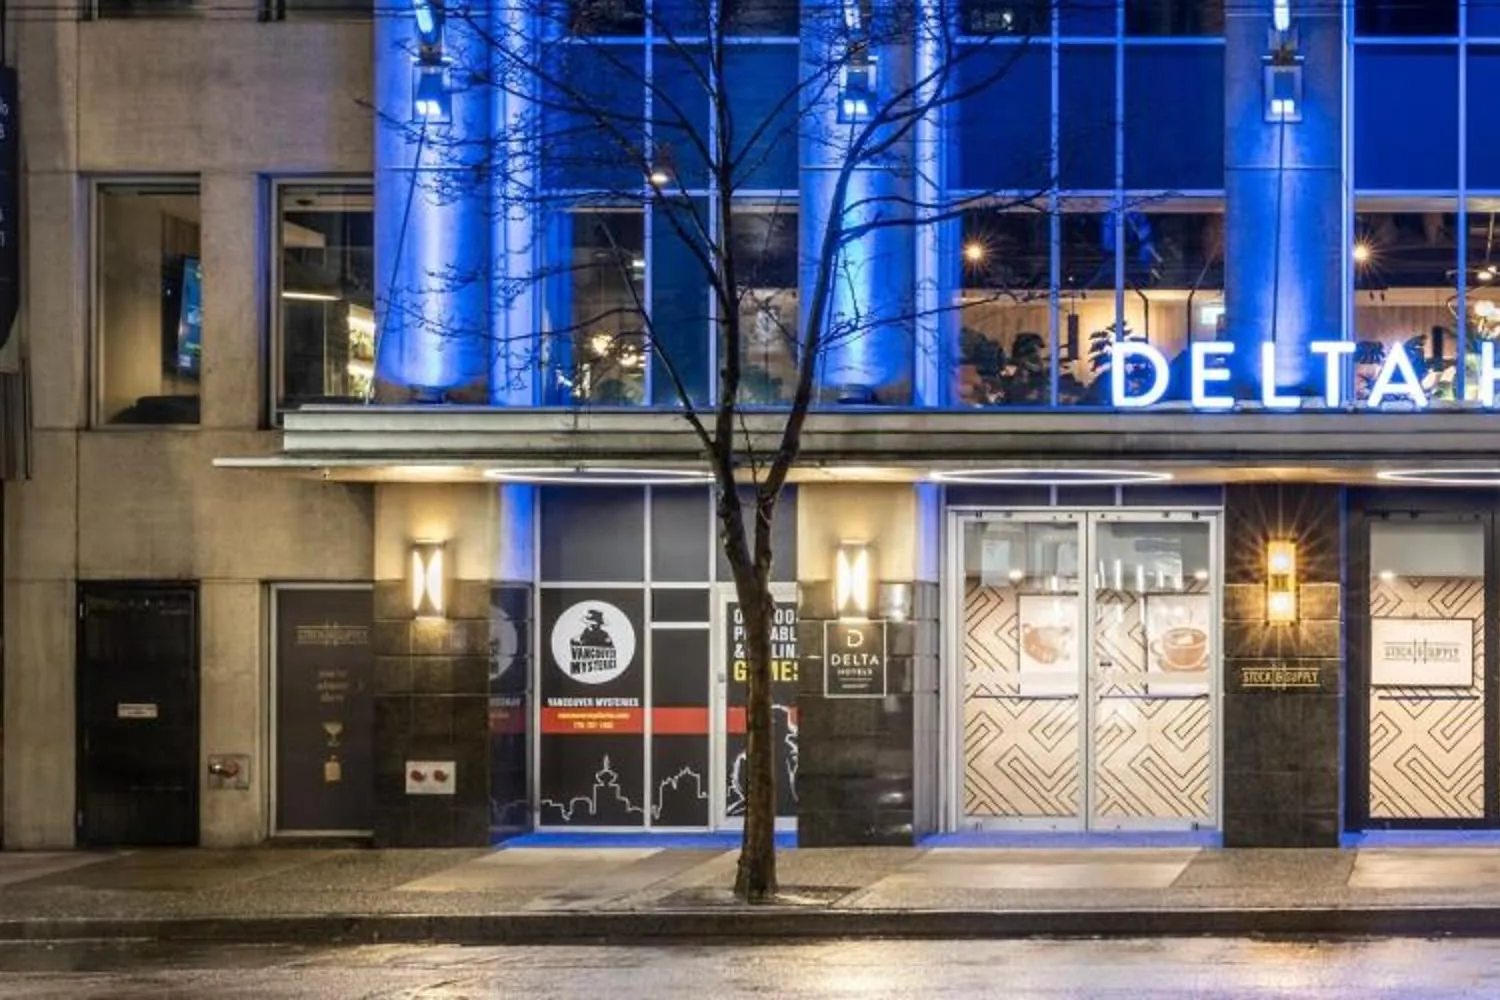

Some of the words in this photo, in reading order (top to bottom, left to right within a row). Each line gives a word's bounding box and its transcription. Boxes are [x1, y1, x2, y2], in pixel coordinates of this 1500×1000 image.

[1111, 341, 1429, 408] DELTA
[572, 647, 617, 660] VANCOUVER
[831, 653, 880, 667] DELTA
[1285, 671, 1318, 683] SUPPLY
[547, 697, 594, 707] VANCOUVER
[595, 697, 640, 707] MYSTERIES
